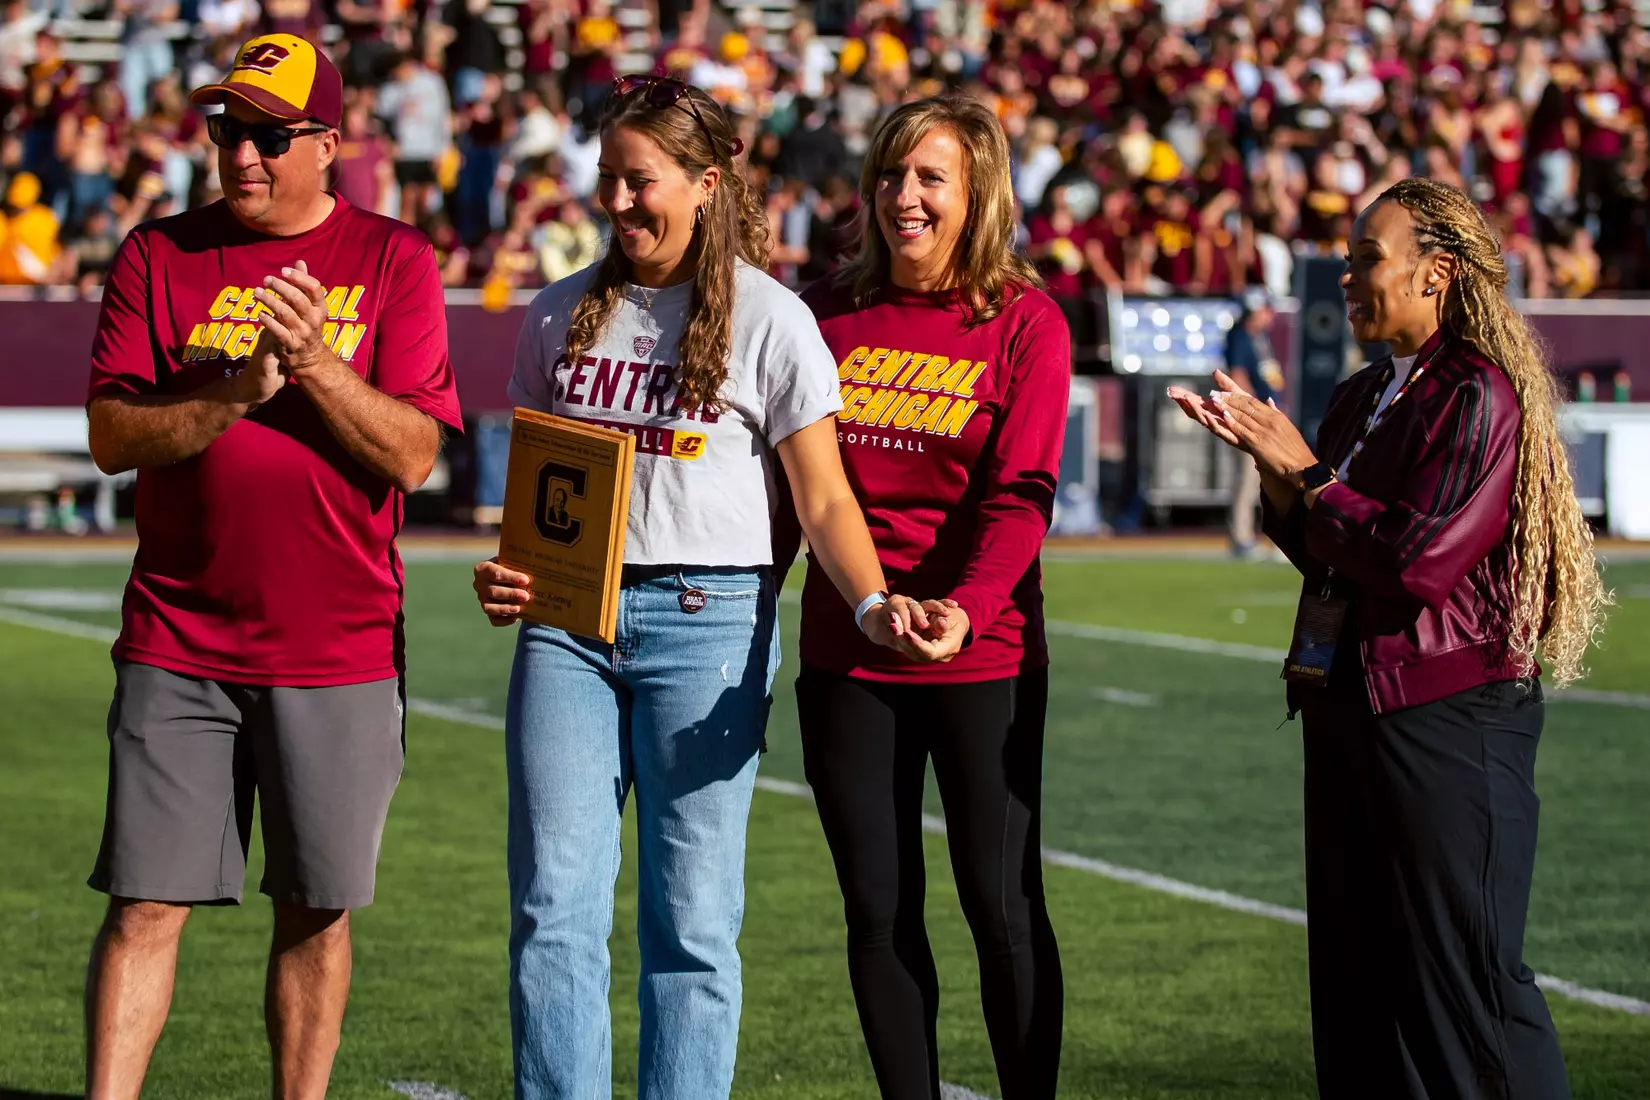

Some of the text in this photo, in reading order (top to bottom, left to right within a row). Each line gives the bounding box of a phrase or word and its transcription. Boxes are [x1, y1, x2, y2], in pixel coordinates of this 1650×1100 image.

[208, 285, 366, 321] CENAL
[182, 322, 367, 363] MICAN
[838, 346, 987, 398] CENTRAL
[834, 385, 979, 438] CHIGAN
[838, 432, 924, 452] SOFTBALL
[533, 457, 589, 548] C
[1300, 666, 1324, 676] ATHLETICS
